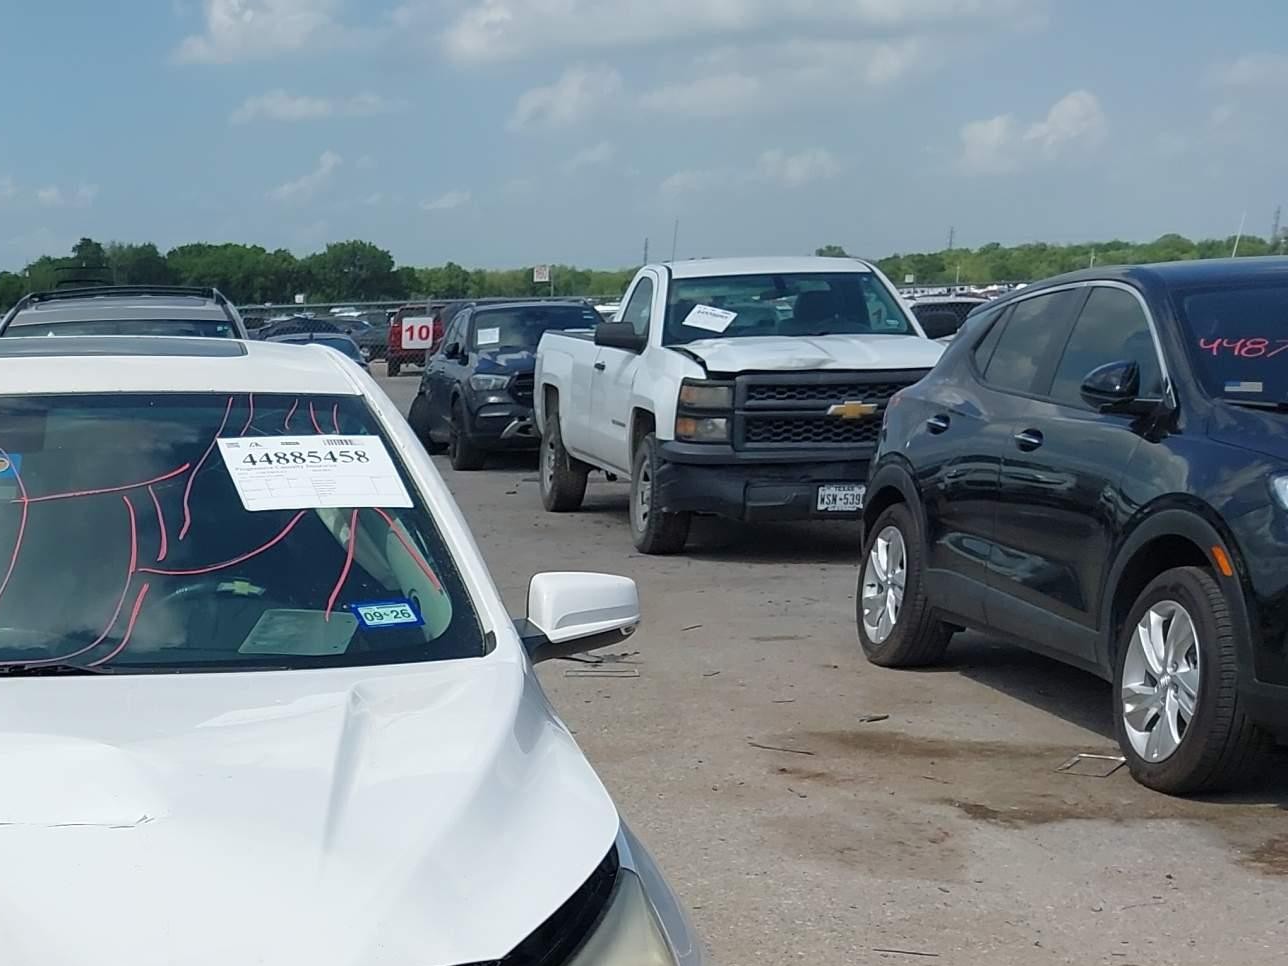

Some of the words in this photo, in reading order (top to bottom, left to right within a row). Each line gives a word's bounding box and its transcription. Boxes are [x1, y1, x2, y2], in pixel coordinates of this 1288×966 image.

[405, 325, 430, 341] 10
[242, 450, 370, 466] 44885458
[364, 611, 384, 622] 09
[390, 609, 411, 619] 26
